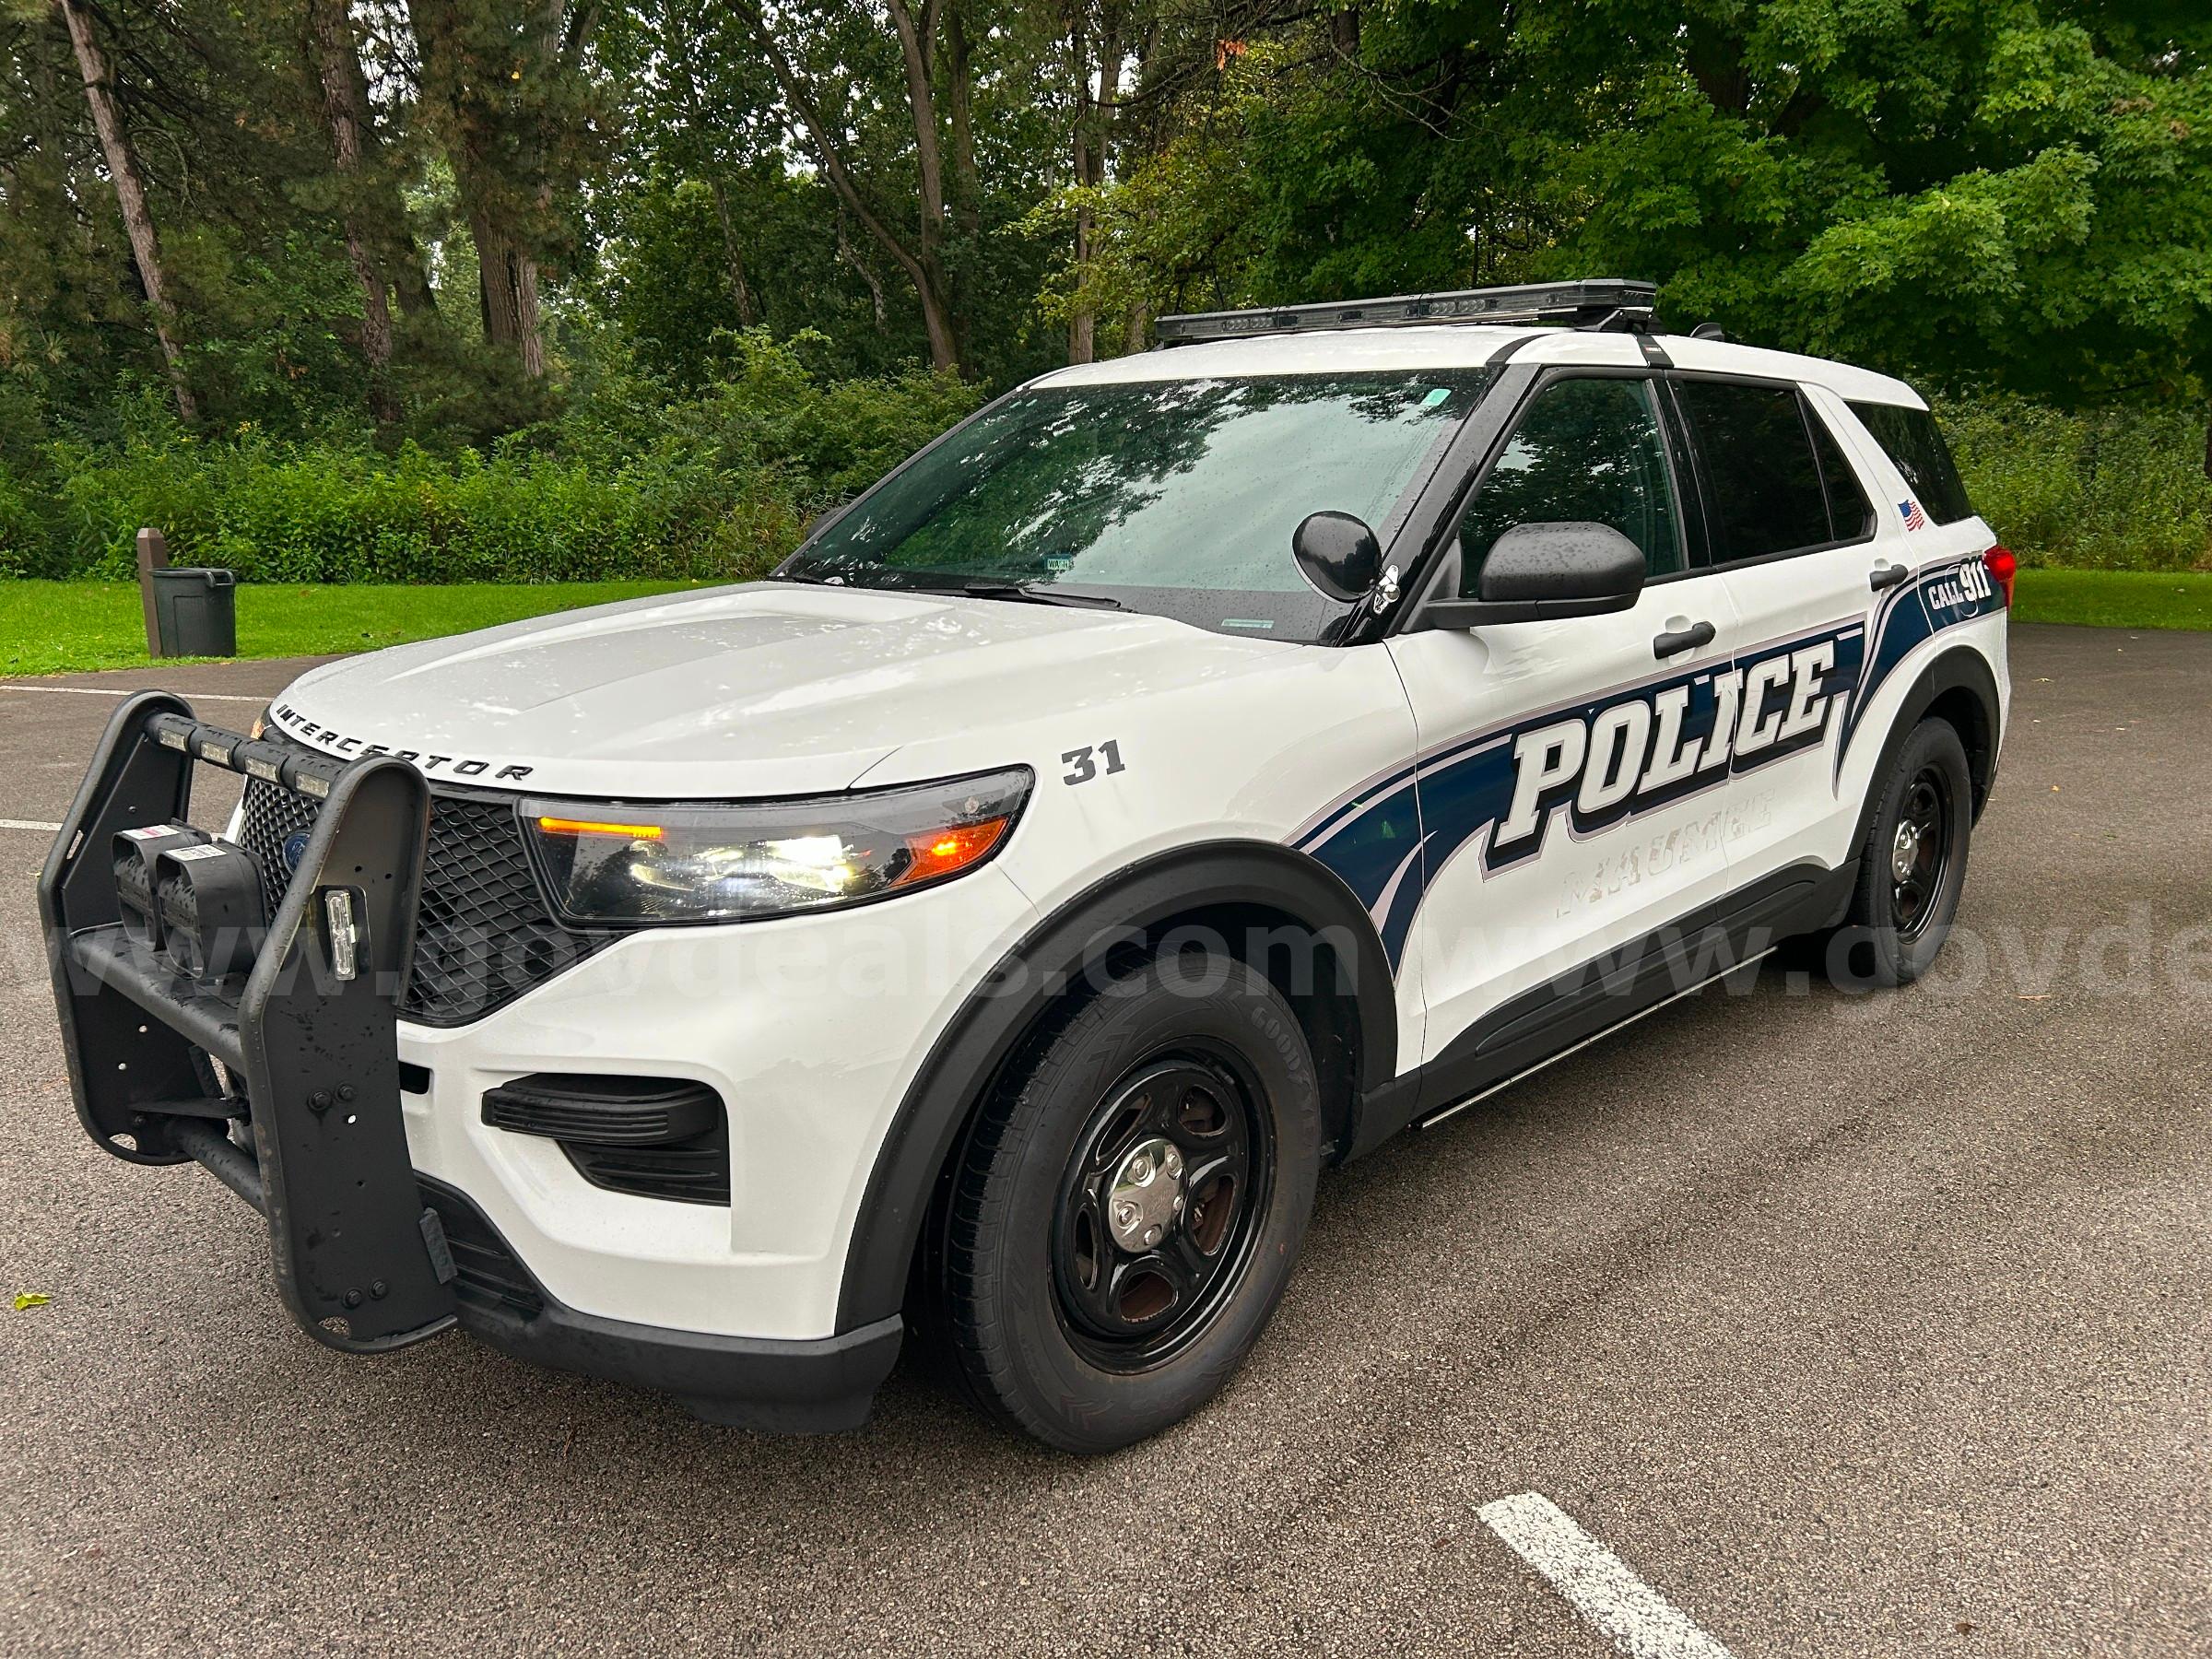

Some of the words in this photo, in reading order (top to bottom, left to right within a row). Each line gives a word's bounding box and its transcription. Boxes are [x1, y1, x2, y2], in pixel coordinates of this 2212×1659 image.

[1927, 581, 1965, 610] CALL
[1959, 560, 1992, 602] 911
[276, 704, 533, 781] INTERCEPTOR
[1062, 739, 1126, 785] 31
[1494, 641, 1834, 848] POLICE
